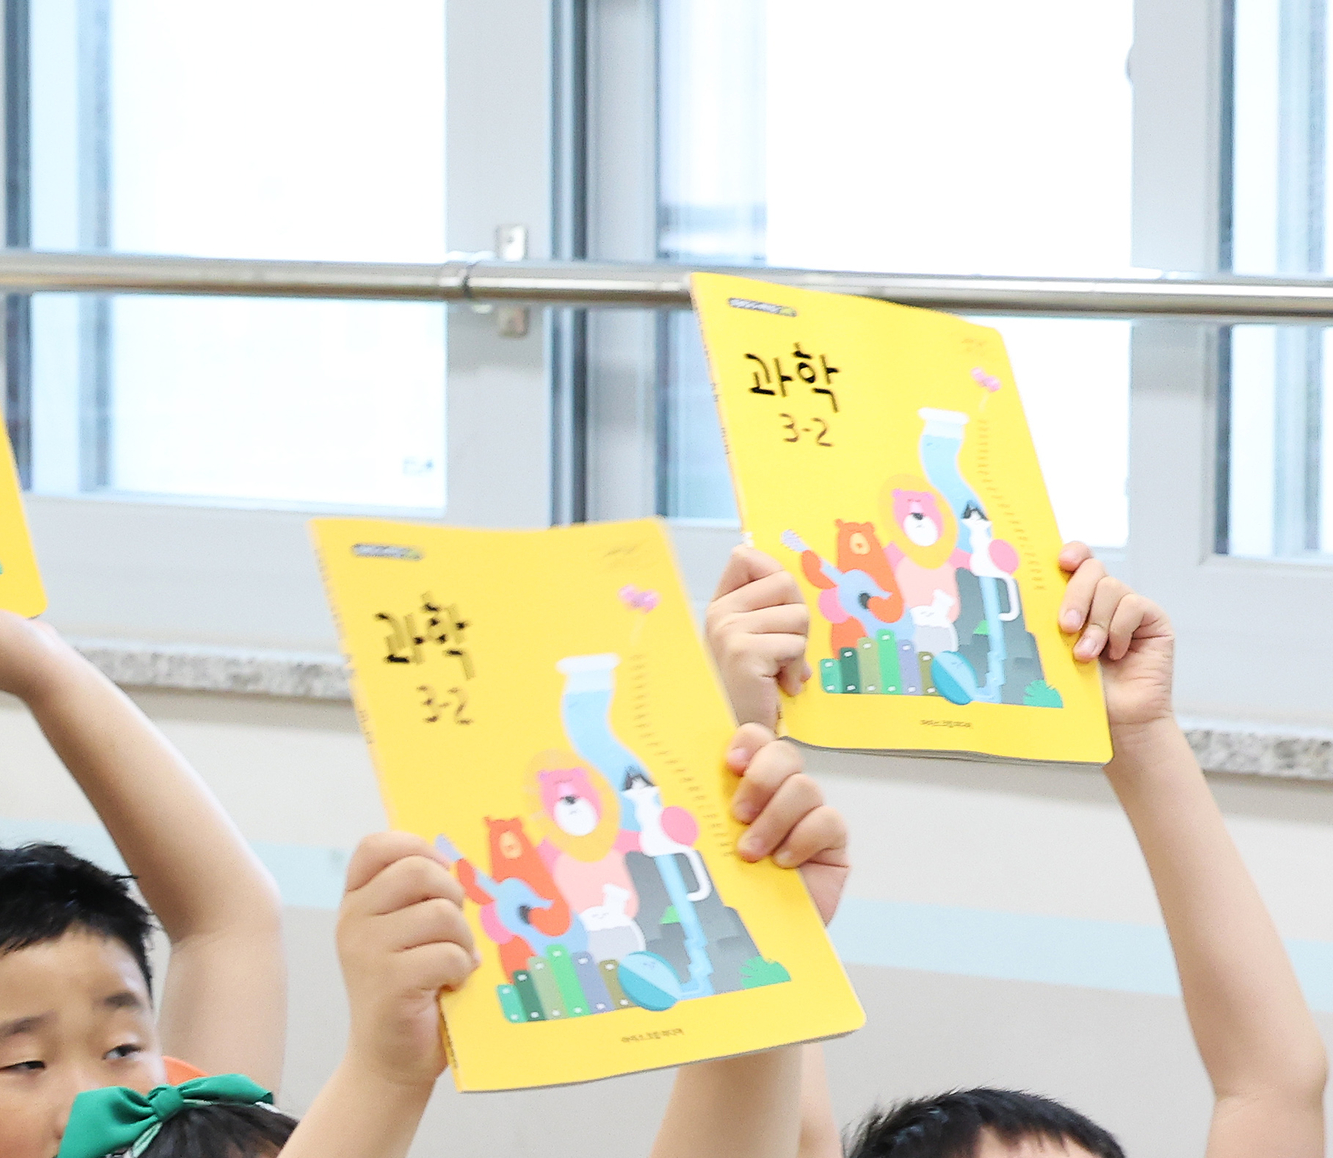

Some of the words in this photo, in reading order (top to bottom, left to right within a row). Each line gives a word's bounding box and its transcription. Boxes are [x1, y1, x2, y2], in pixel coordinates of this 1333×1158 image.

[744, 342, 841, 413] 과학
[779, 412, 834, 447] 3-2
[373, 590, 476, 681] 과학
[415, 684, 474, 726] 3-2
